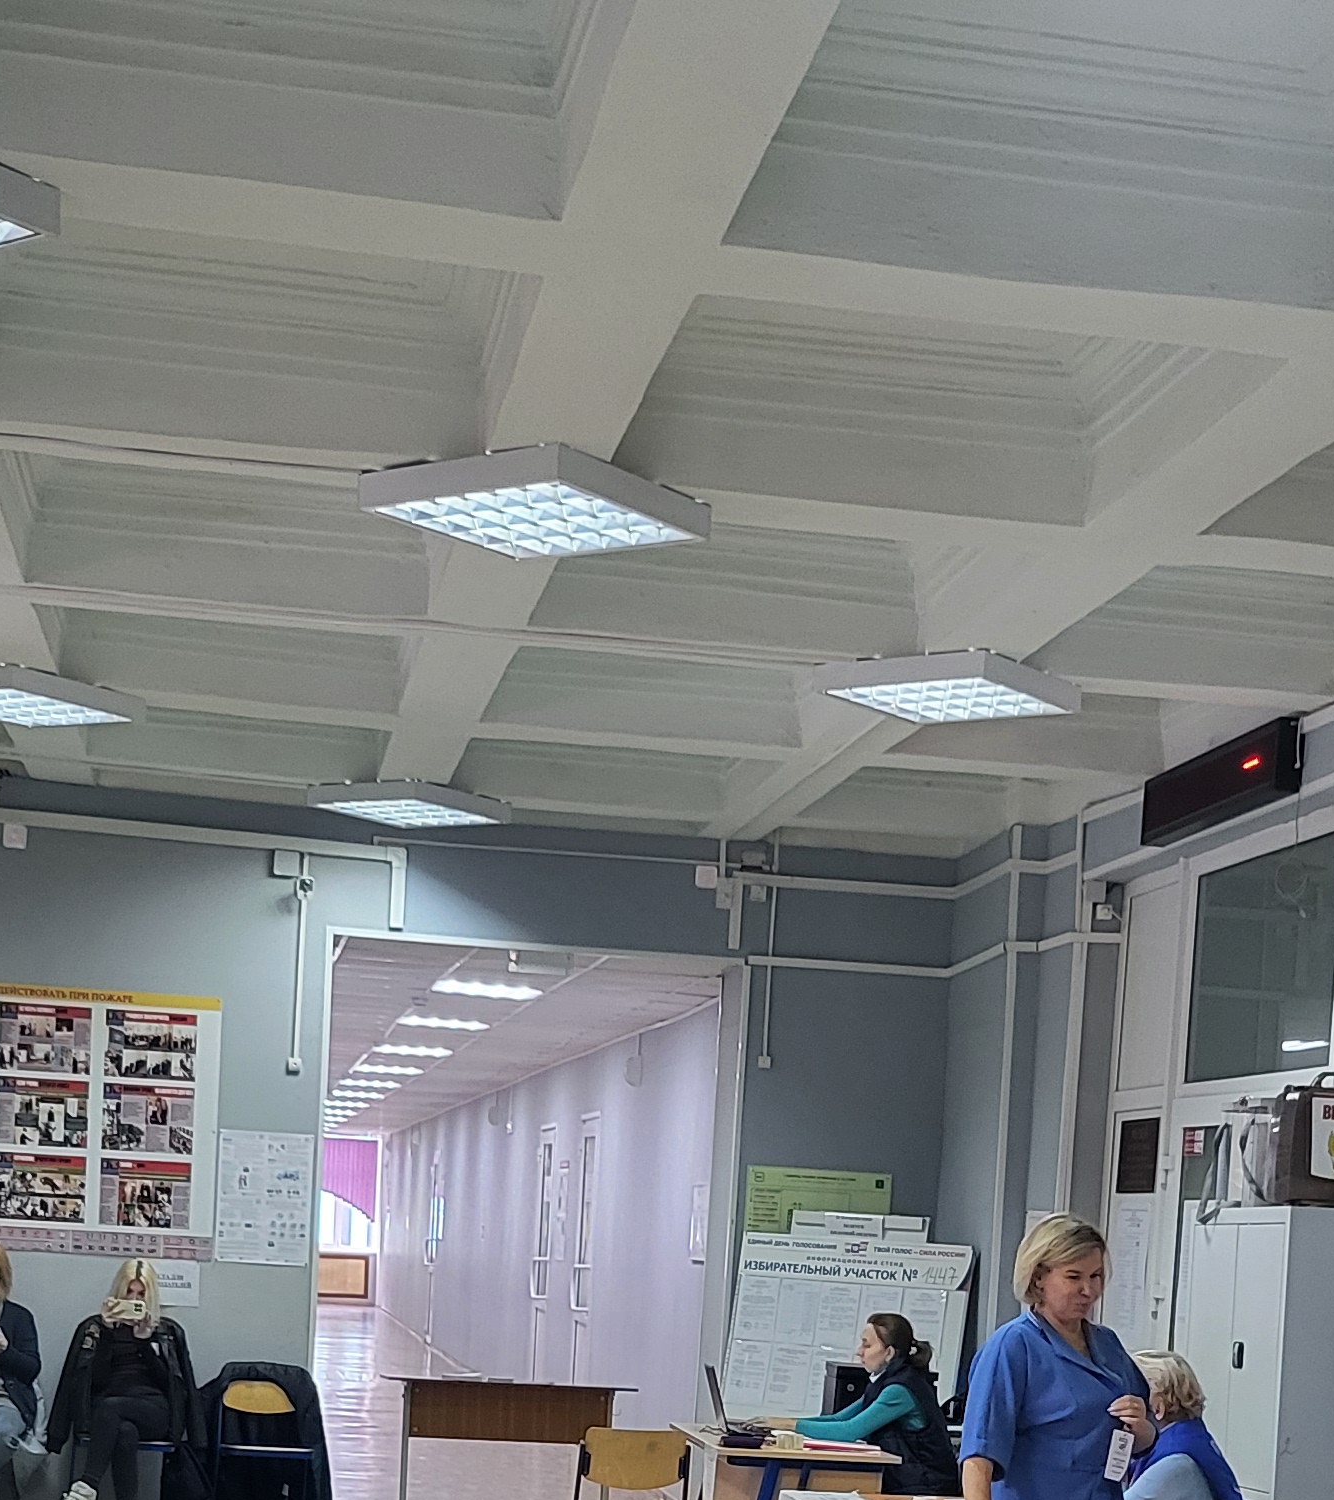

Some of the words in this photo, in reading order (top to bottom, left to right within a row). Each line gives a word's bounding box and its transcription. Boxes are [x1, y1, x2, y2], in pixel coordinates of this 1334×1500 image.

[69, 991, 89, 1000] ПРИ
[91, 993, 134, 1003] ПОЖАРЕ
[873, 1245, 890, 1253] ТВОЙ
[891, 1247, 913, 1255] ГОЛОС
[880, 1260, 904, 1268] СТЕНД
[743, 1259, 841, 1277] ИЗБИРАТЕЛЬНЫЙ
[843, 1267, 898, 1281] УЧАСТОК
[901, 1268, 919, 1283] №
